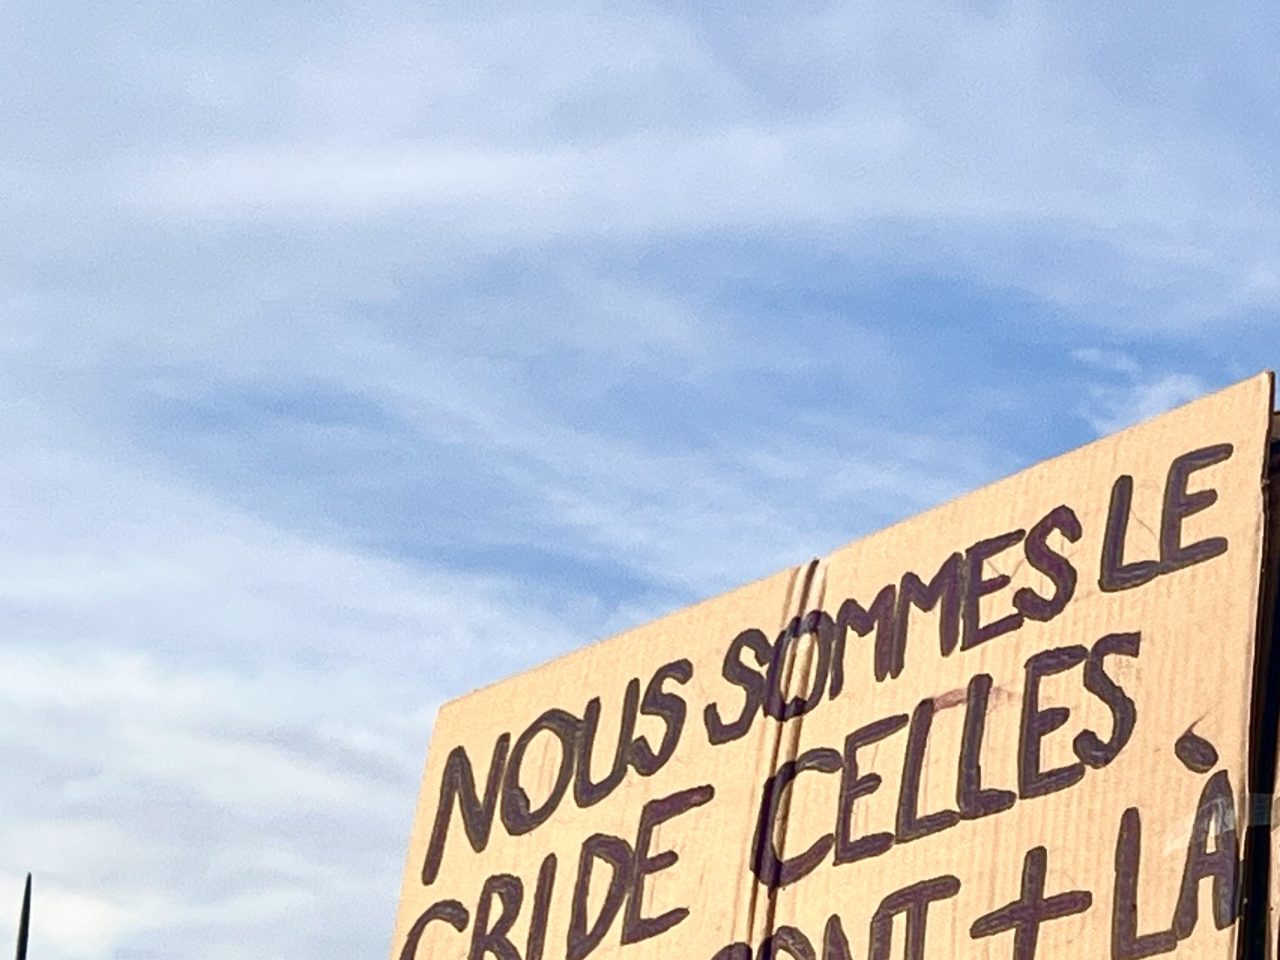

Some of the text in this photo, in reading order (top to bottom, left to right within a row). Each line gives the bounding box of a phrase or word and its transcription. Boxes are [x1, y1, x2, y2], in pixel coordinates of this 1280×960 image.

[423, 442, 1233, 885] NOUS SOMMES LE
[751, 631, 1142, 887] CELLES
